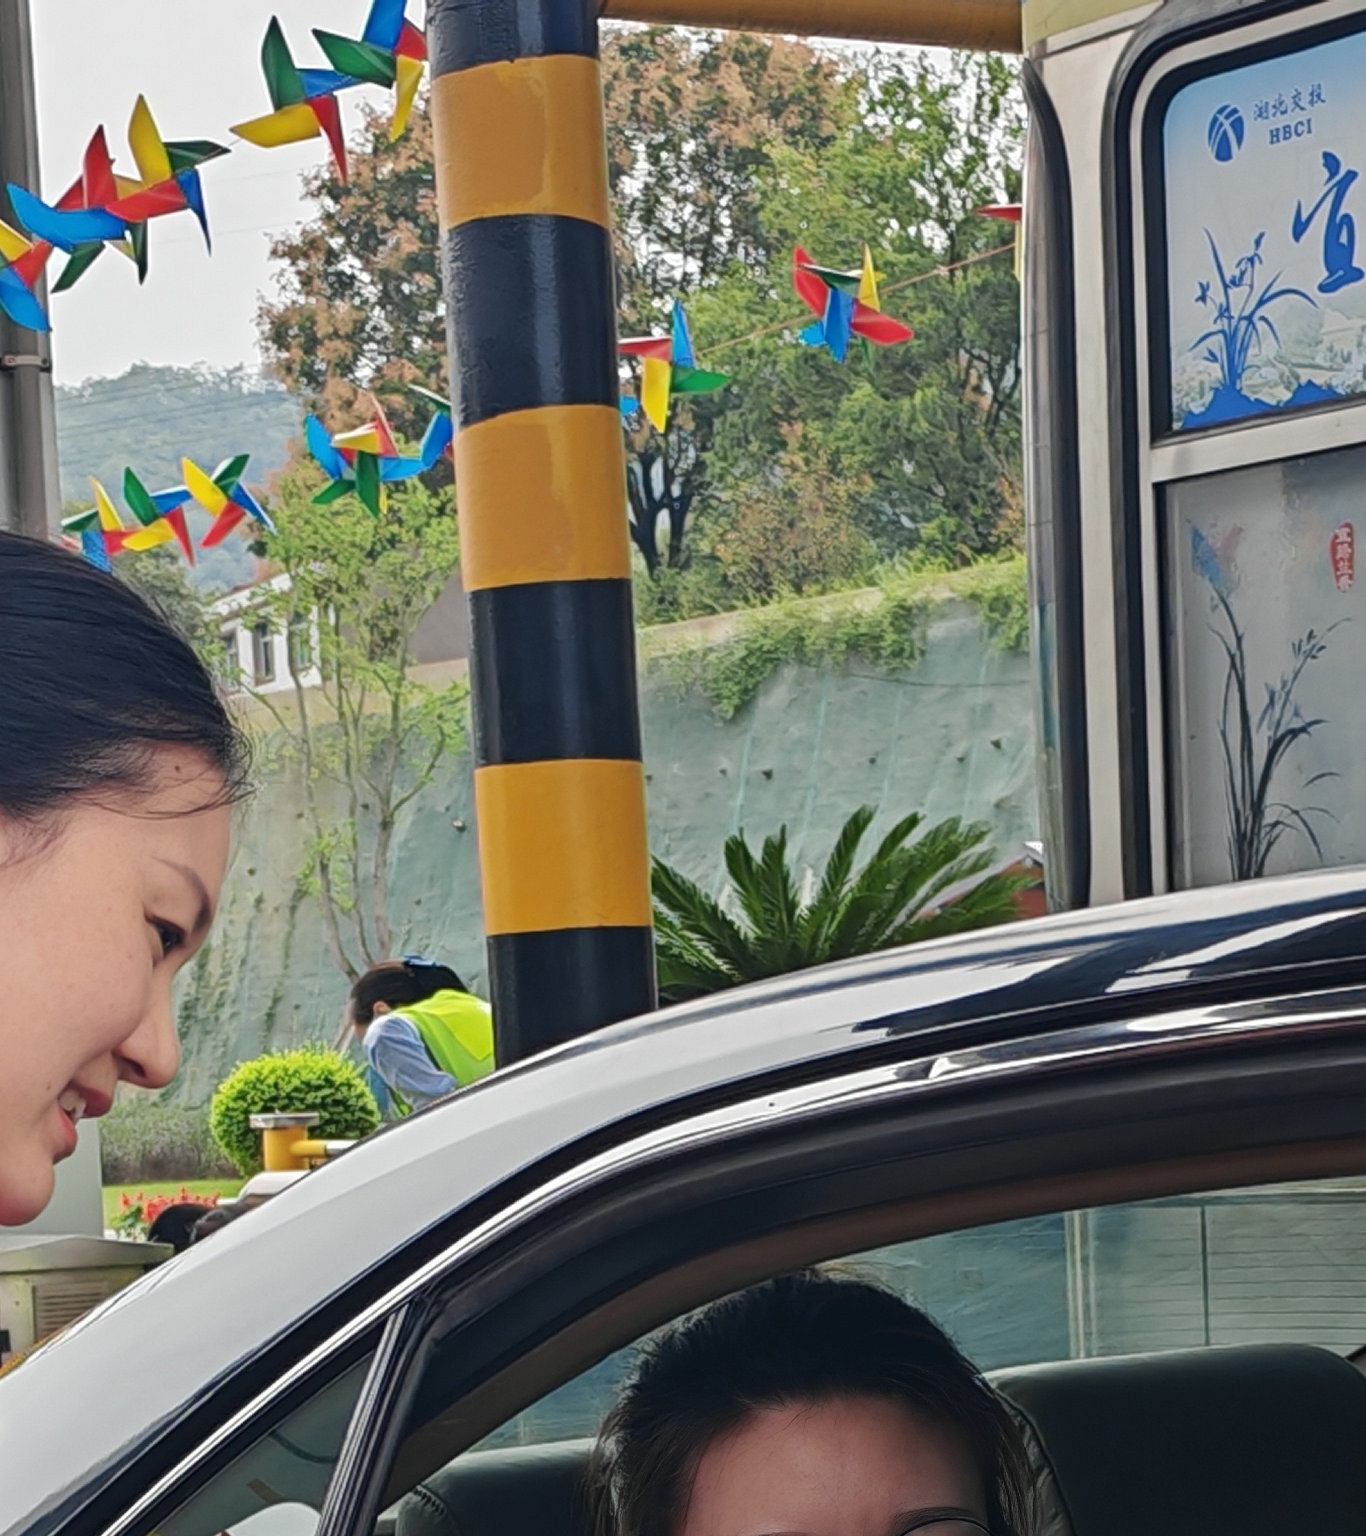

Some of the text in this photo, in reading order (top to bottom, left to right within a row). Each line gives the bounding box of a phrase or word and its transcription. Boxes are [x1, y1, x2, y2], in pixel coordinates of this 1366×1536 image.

[1253, 83, 1326, 122] 湖北交投
[1268, 117, 1314, 145] HBCI
